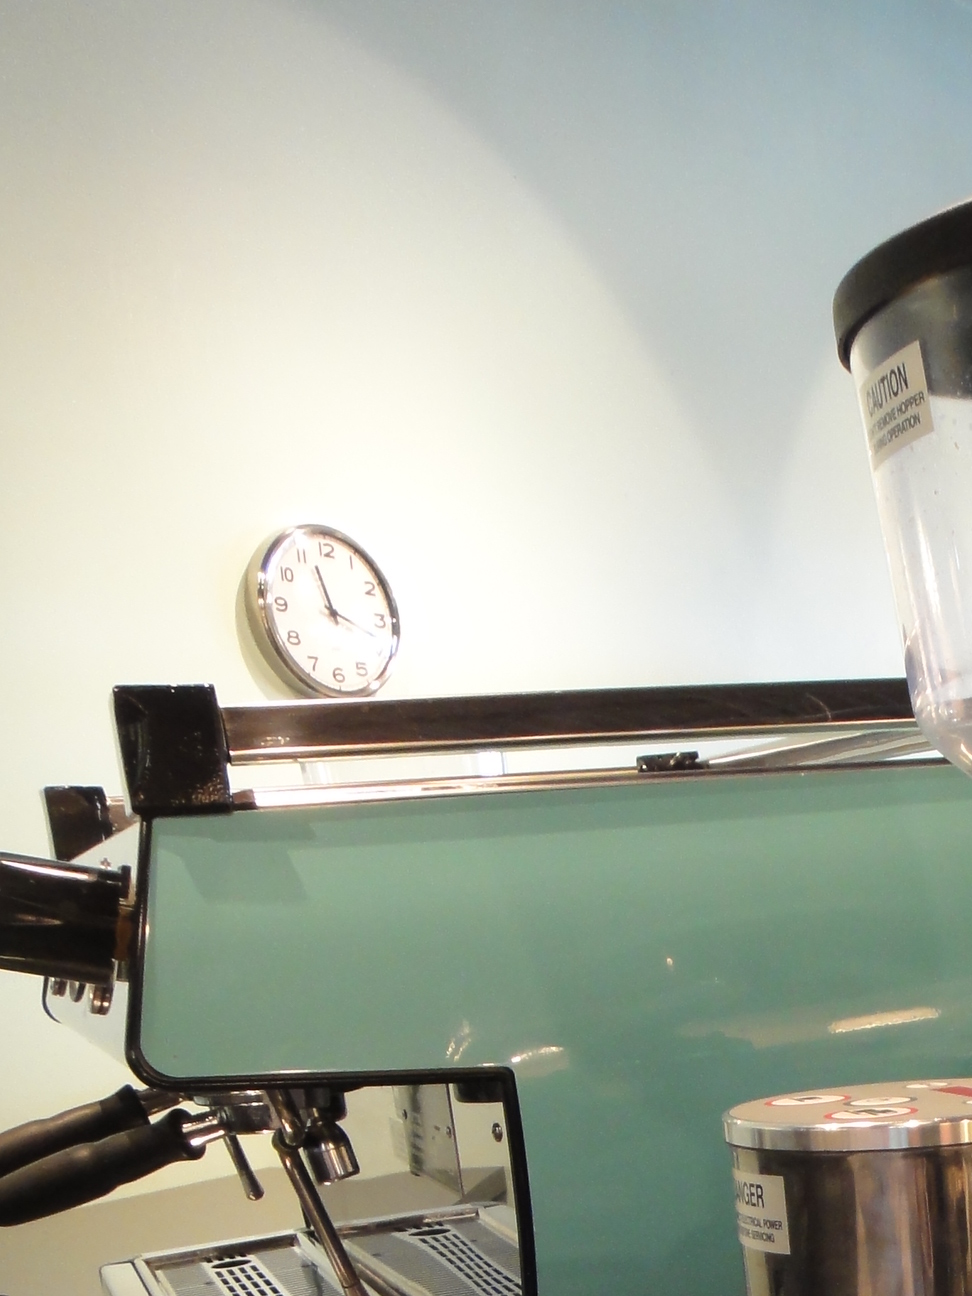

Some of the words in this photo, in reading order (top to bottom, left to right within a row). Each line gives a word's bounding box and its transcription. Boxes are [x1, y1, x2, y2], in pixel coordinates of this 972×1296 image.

[867, 362, 909, 417] CAUTION
[896, 391, 925, 416] HOPPER
[886, 412, 921, 442] OPERATION
[296, 548, 307, 564] 11
[318, 541, 335, 559] 12
[280, 566, 294, 583] 10
[364, 581, 376, 597] 2
[274, 597, 288, 612] 9
[374, 613, 386, 629] 3
[287, 630, 301, 646] 8
[307, 655, 319, 672] 7
[355, 661, 368, 677] 5
[332, 667, 346, 683] 6
[763, 1218, 783, 1230] POWER
